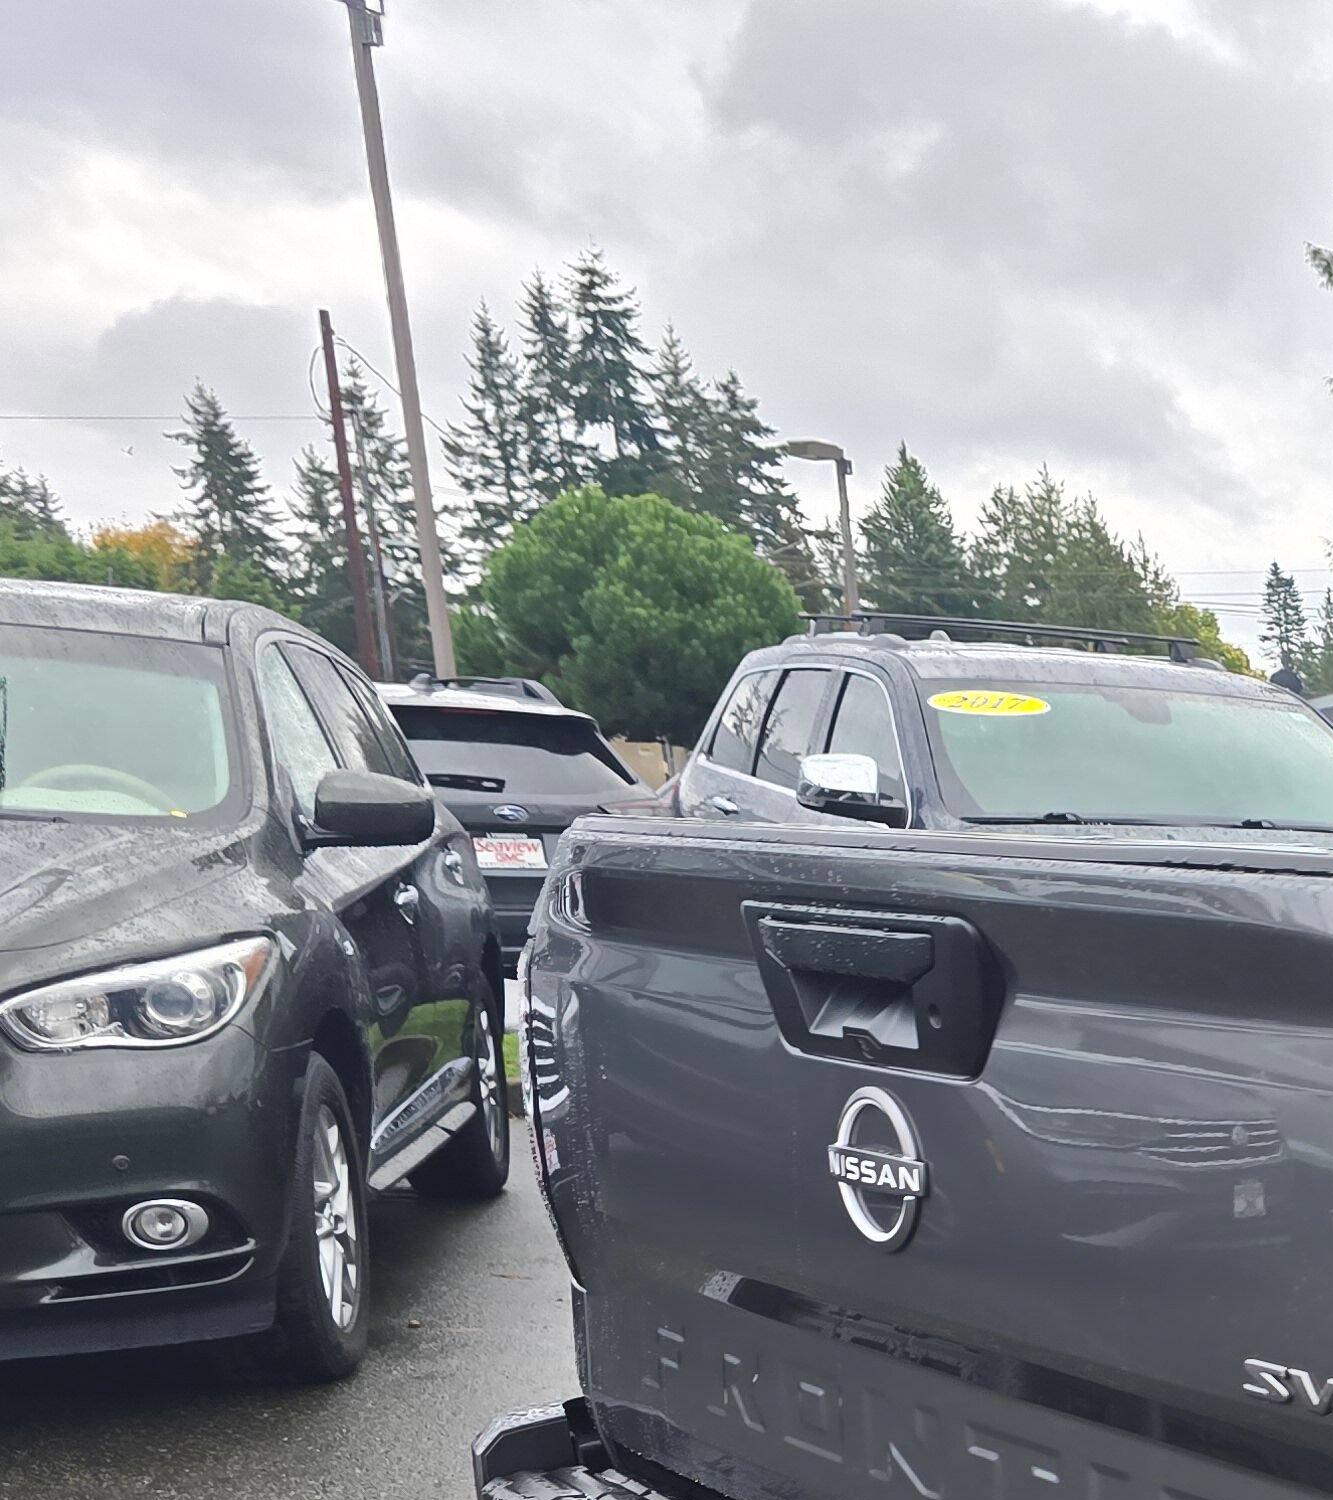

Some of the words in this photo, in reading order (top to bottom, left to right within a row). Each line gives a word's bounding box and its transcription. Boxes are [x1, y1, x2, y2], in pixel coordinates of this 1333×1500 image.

[947, 696, 1028, 710] 2017
[475, 841, 540, 853] Seaview
[828, 1150, 920, 1192] NISSAN
